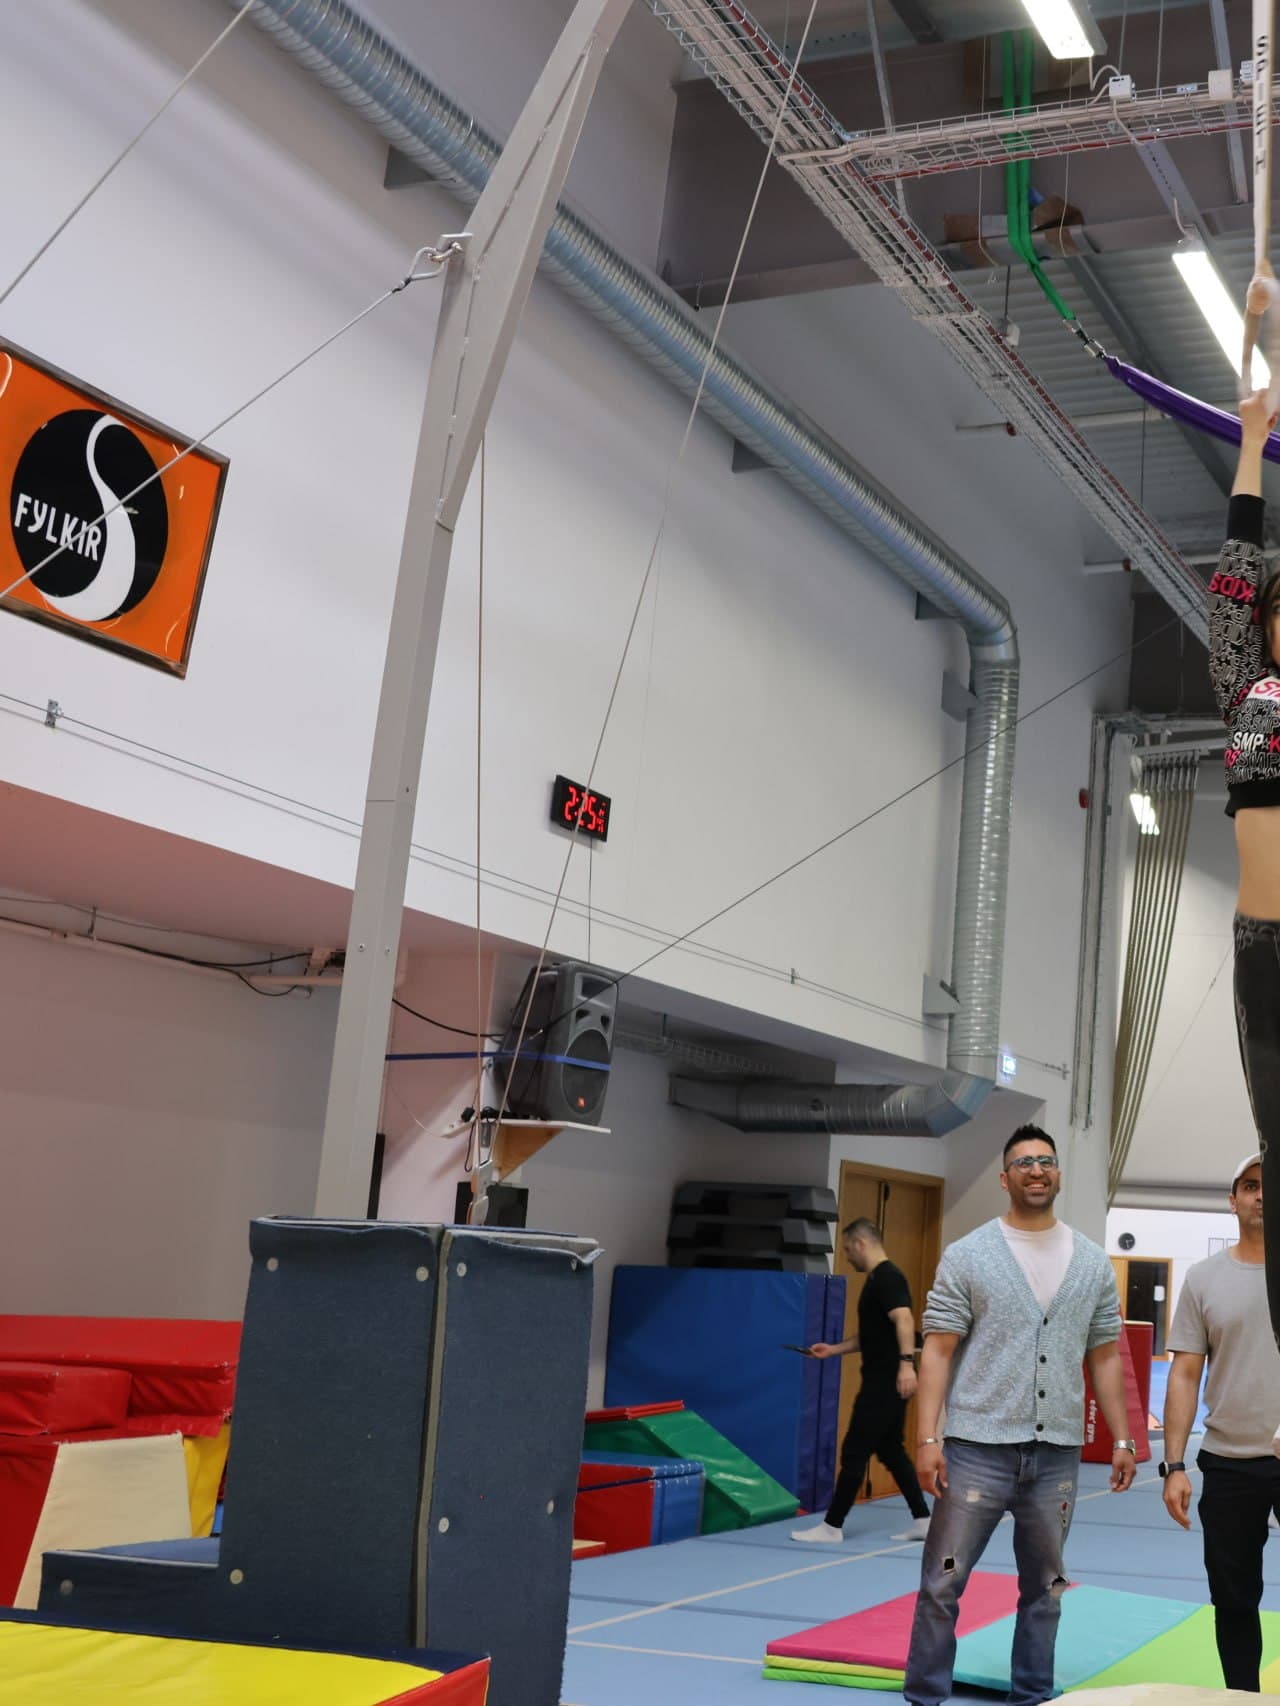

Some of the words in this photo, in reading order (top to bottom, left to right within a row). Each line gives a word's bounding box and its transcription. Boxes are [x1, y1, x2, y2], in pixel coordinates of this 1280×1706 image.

[14, 493, 102, 561] FYLKIR
[1232, 731, 1265, 751] SMP
[565, 786, 597, 830] 2:25
